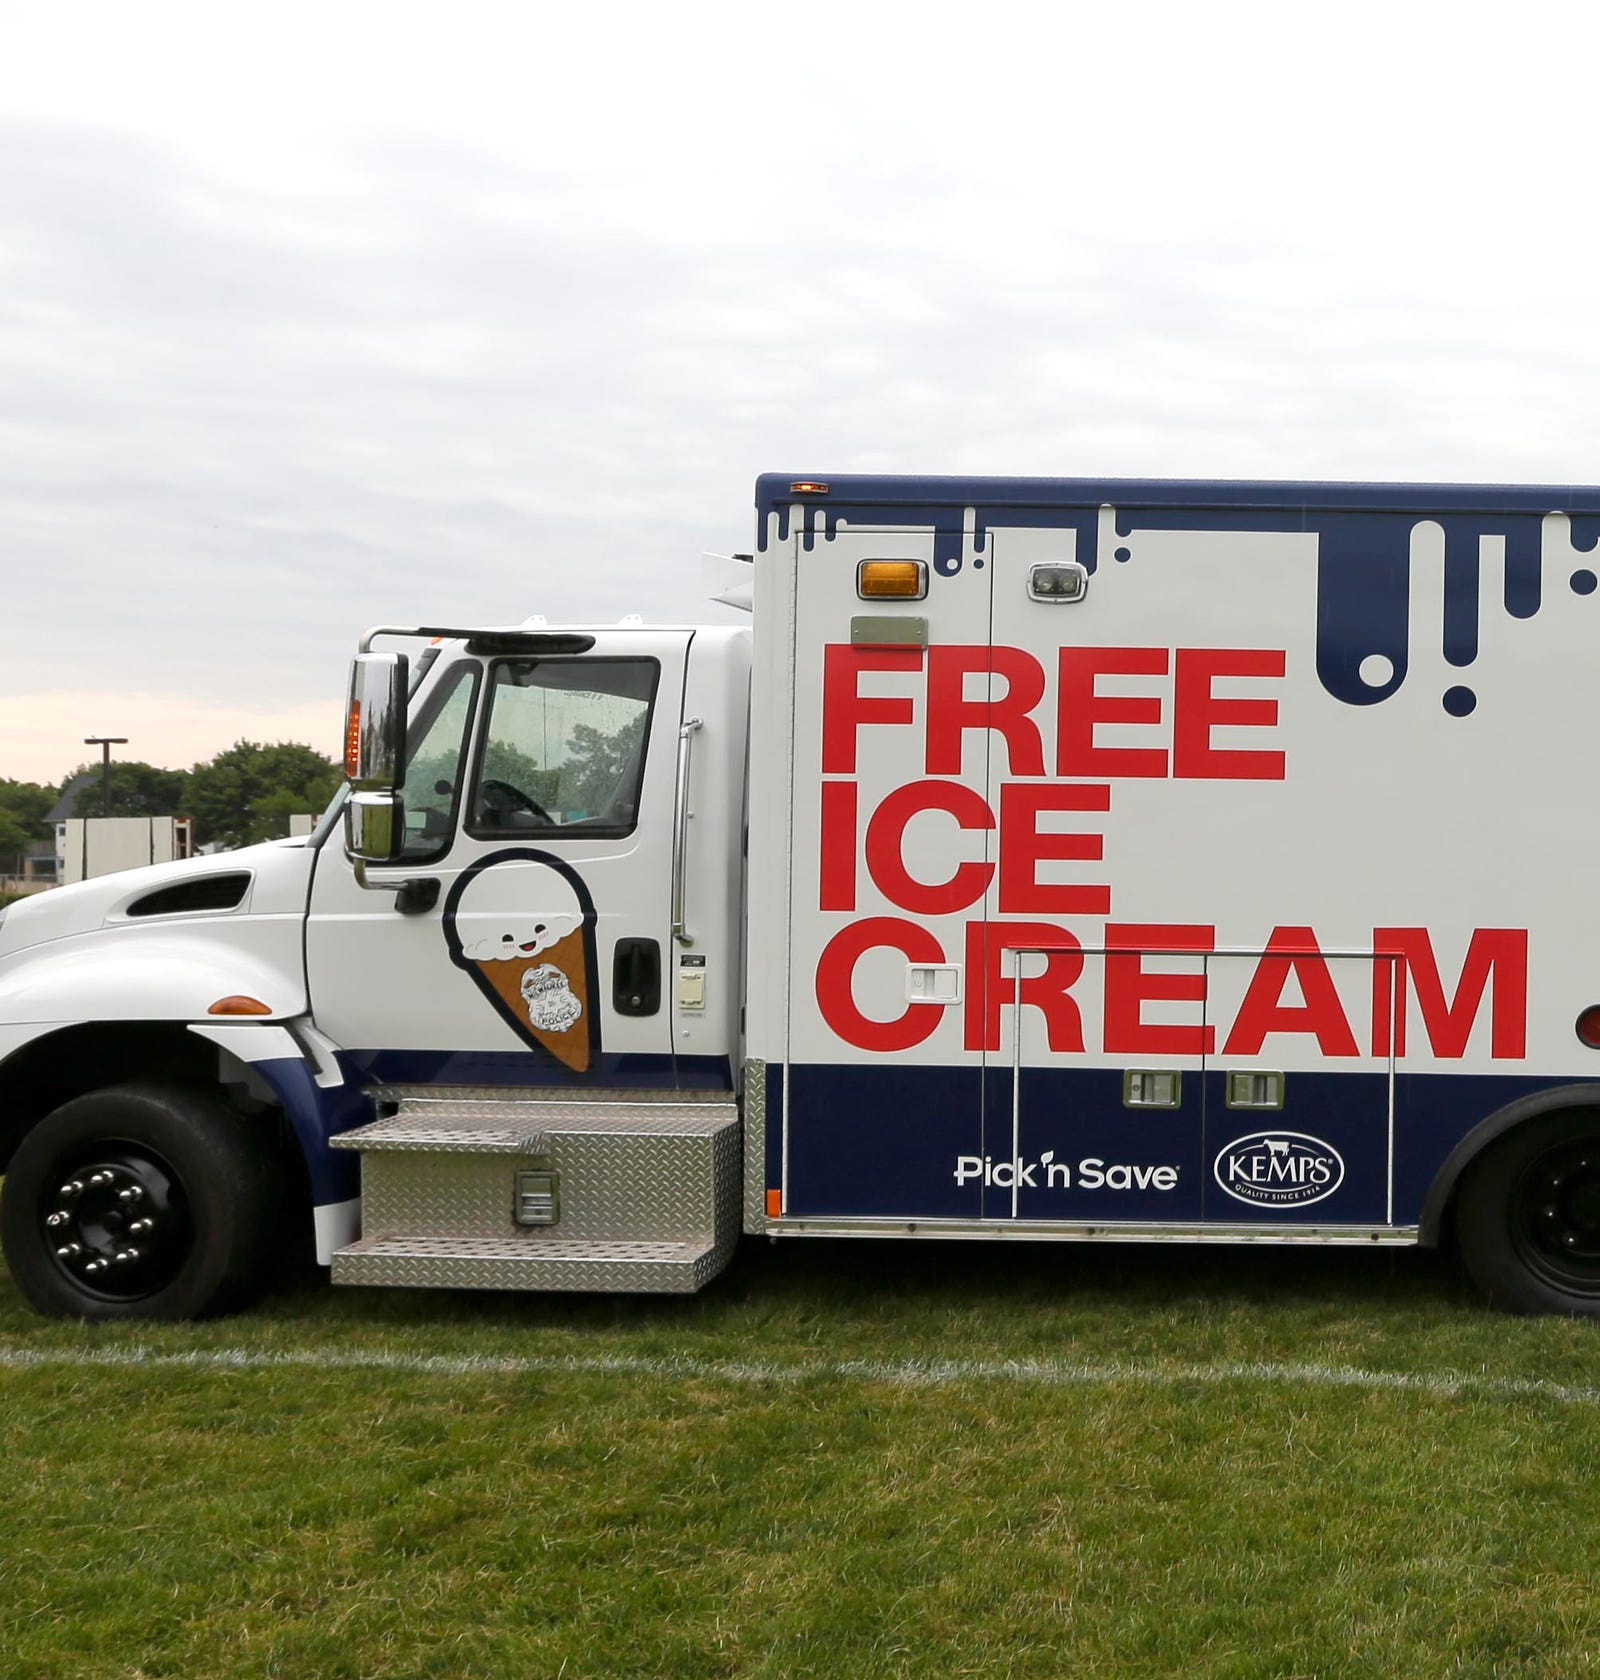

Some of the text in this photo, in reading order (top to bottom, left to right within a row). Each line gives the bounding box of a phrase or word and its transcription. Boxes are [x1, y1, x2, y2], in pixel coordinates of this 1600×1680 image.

[822, 643, 1286, 780] FREE
[819, 779, 1111, 915] ICE
[815, 916, 1528, 1059] CREAM
[541, 1006, 577, 1025] POLICE
[953, 1156, 1038, 1188] Pick
[1078, 1158, 1178, 1190] Save
[1228, 1155, 1331, 1184] KEMPS
[1234, 1183, 1270, 1200] QUALITY
[1272, 1192, 1300, 1201] SINCE
